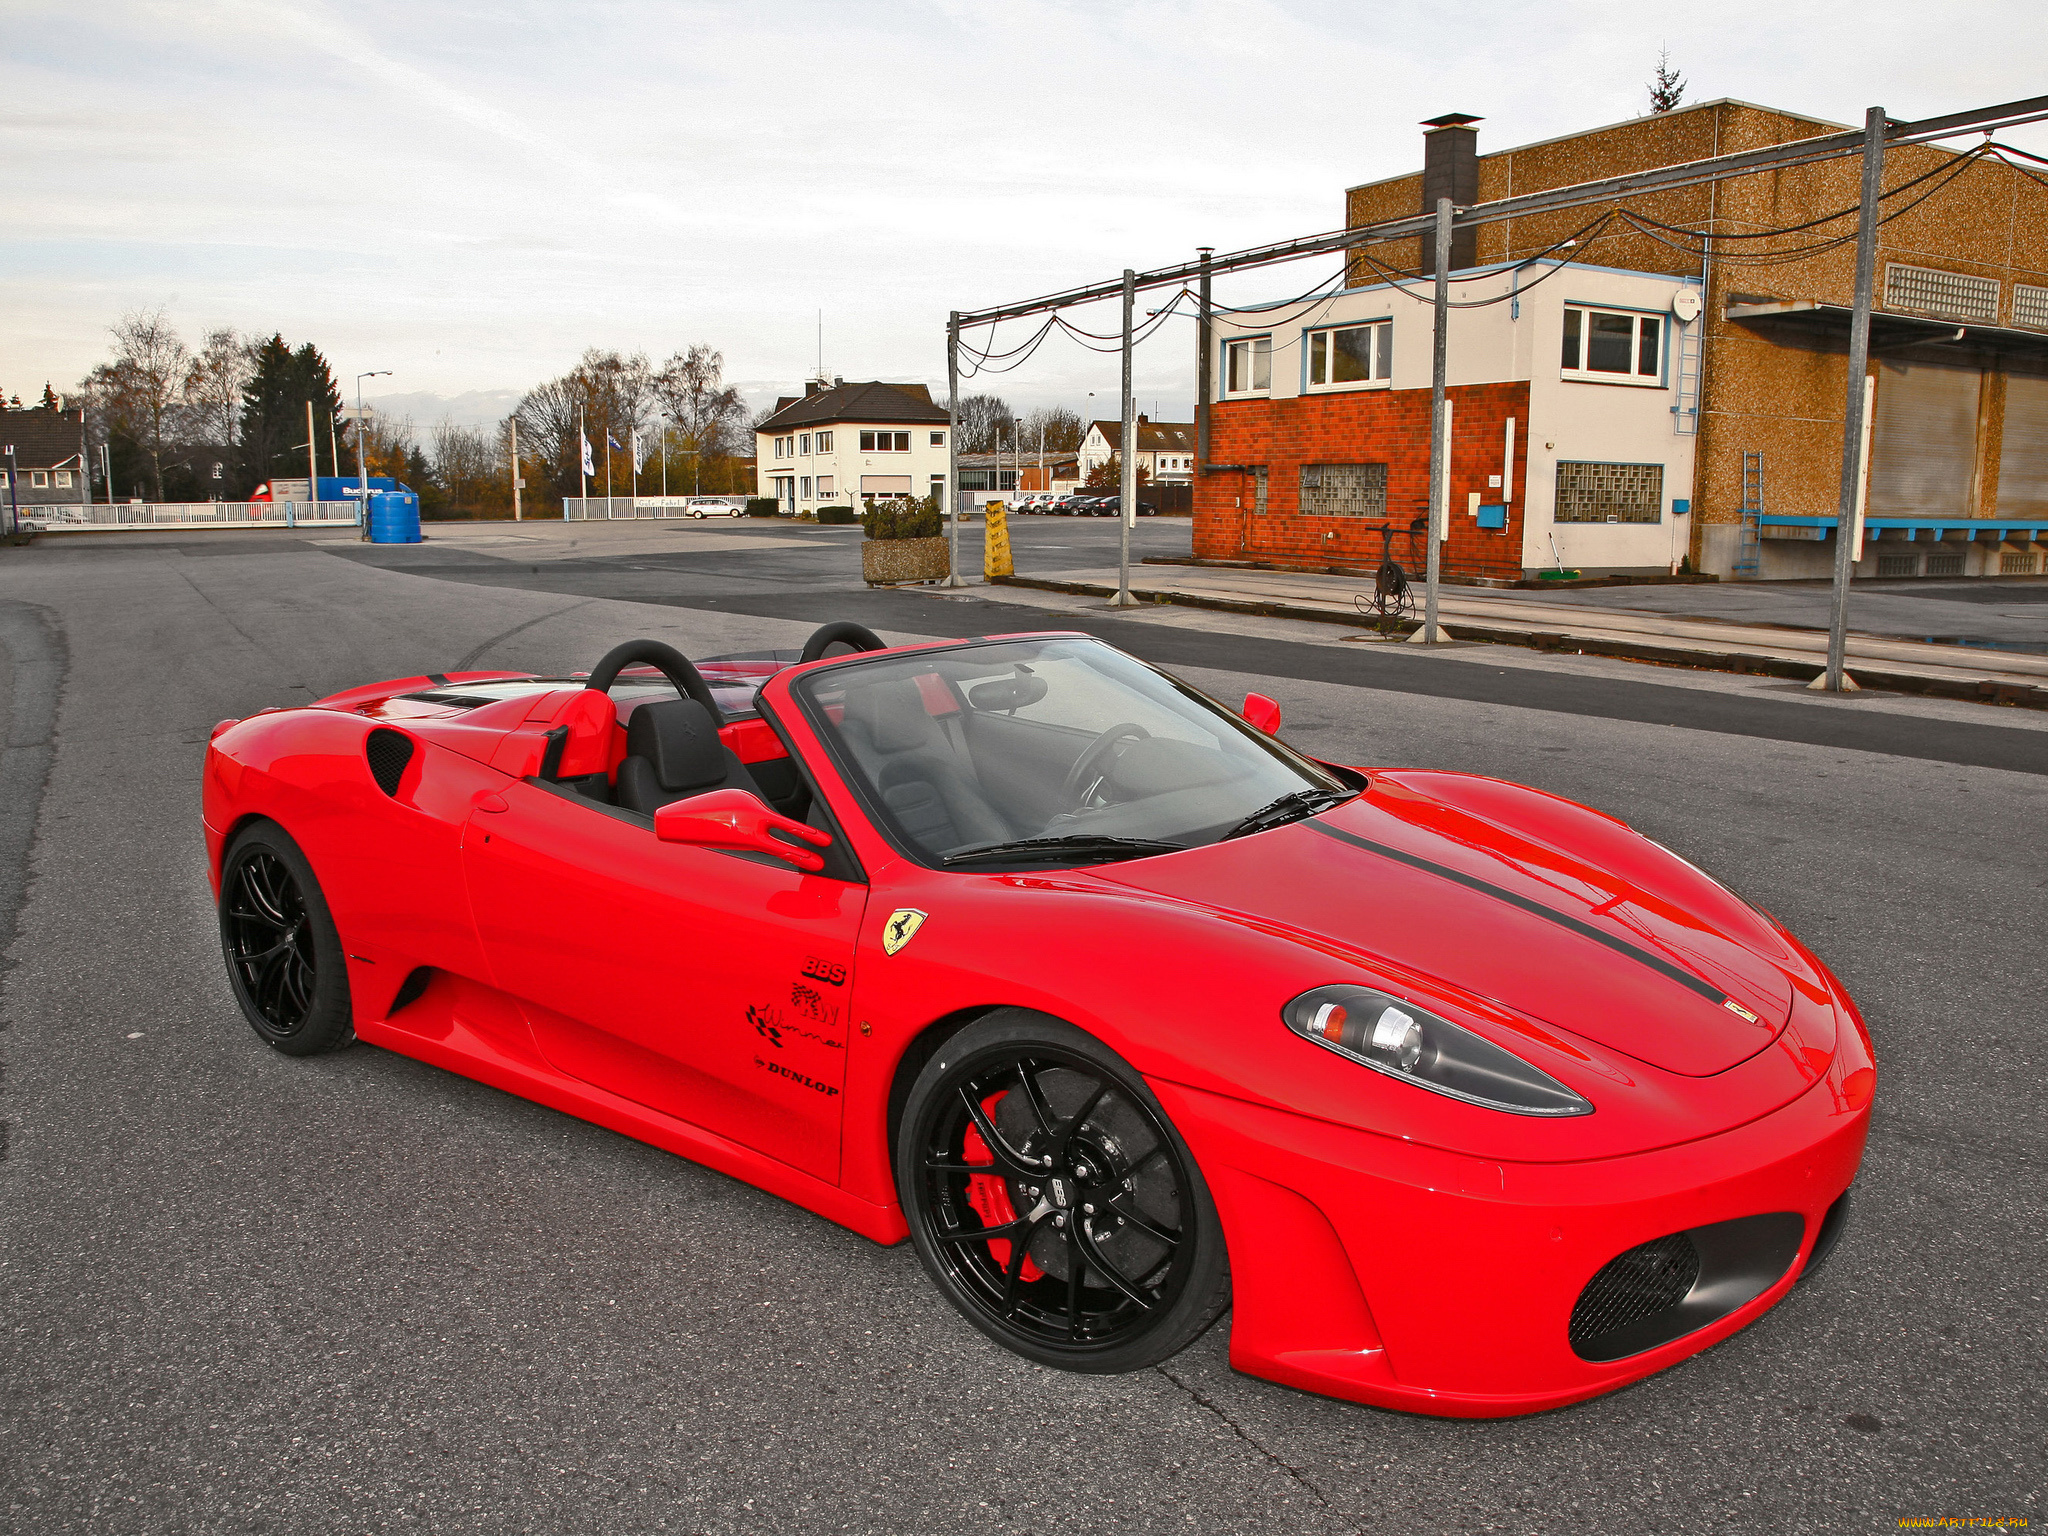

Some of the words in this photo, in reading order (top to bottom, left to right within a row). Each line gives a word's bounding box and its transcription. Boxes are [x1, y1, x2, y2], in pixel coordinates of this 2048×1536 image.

[801, 955, 846, 987] BBS
[767, 1061, 839, 1097] DUNLOP
[1052, 1178, 1067, 1207] BBS
